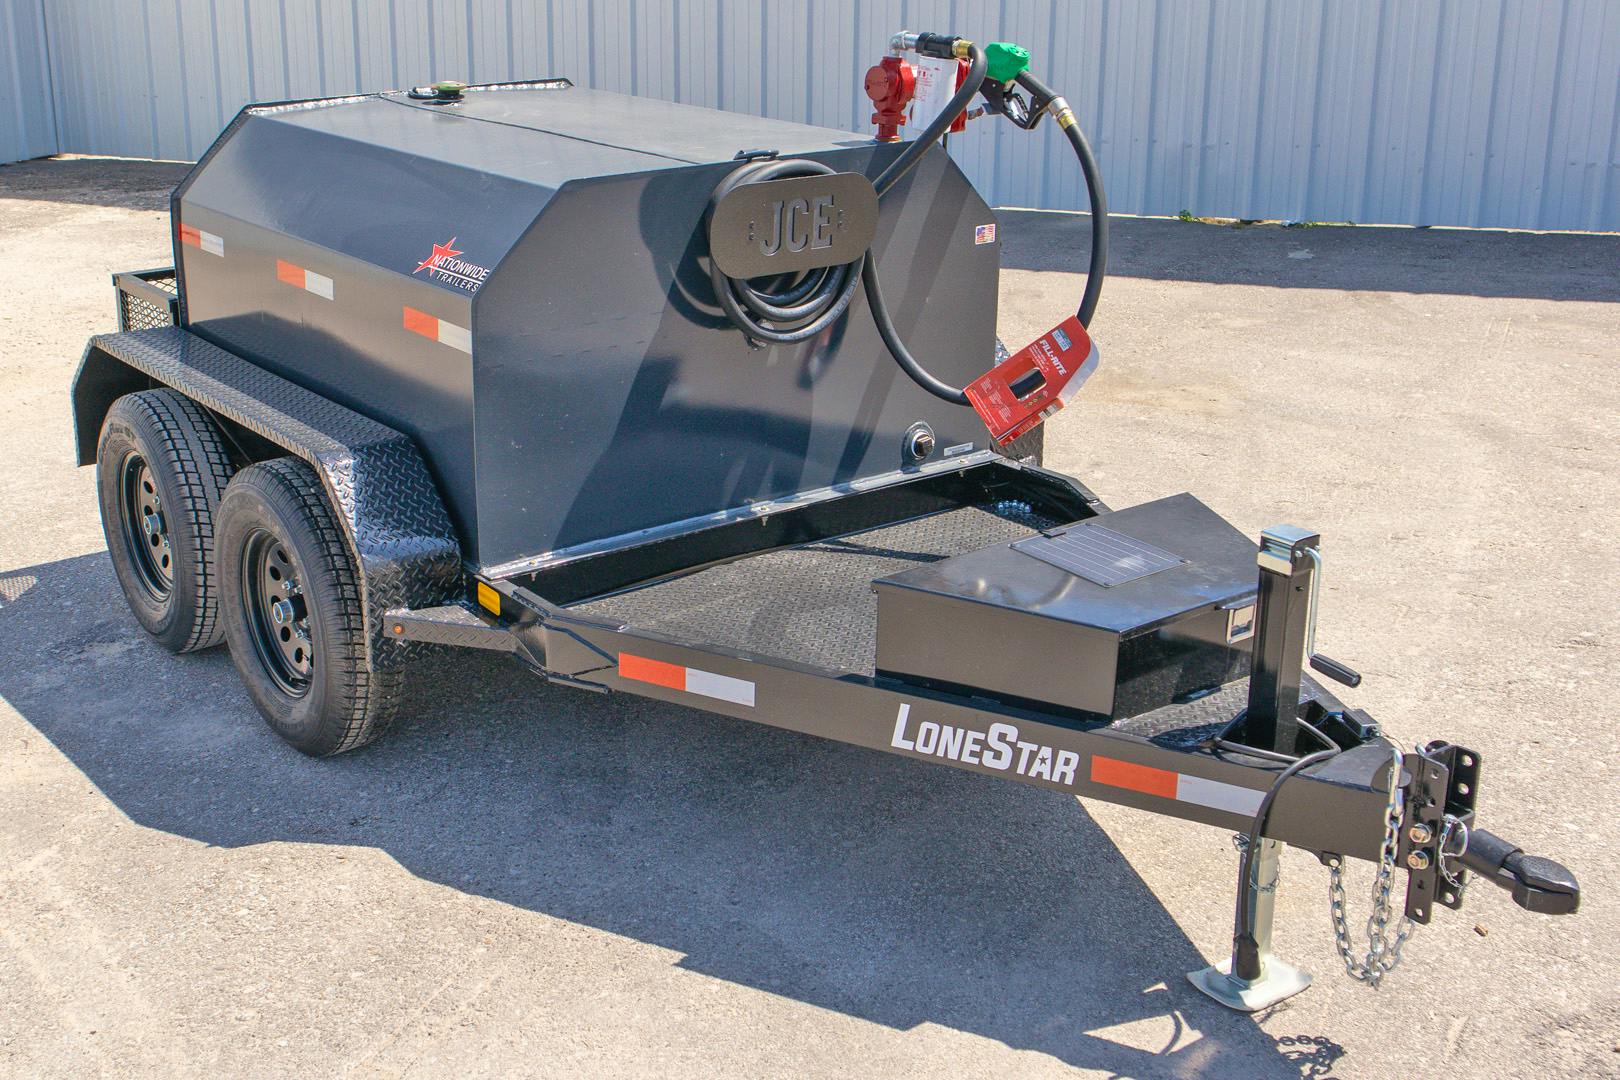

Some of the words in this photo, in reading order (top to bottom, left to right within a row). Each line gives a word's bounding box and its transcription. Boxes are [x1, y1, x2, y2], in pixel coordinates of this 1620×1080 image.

[760, 195, 834, 256] JCE
[431, 254, 490, 280] NATIONWIDE
[436, 271, 479, 292] TRAILERS
[1040, 339, 1067, 376] FILL-RITE
[891, 703, 1080, 785] LONESTAR
